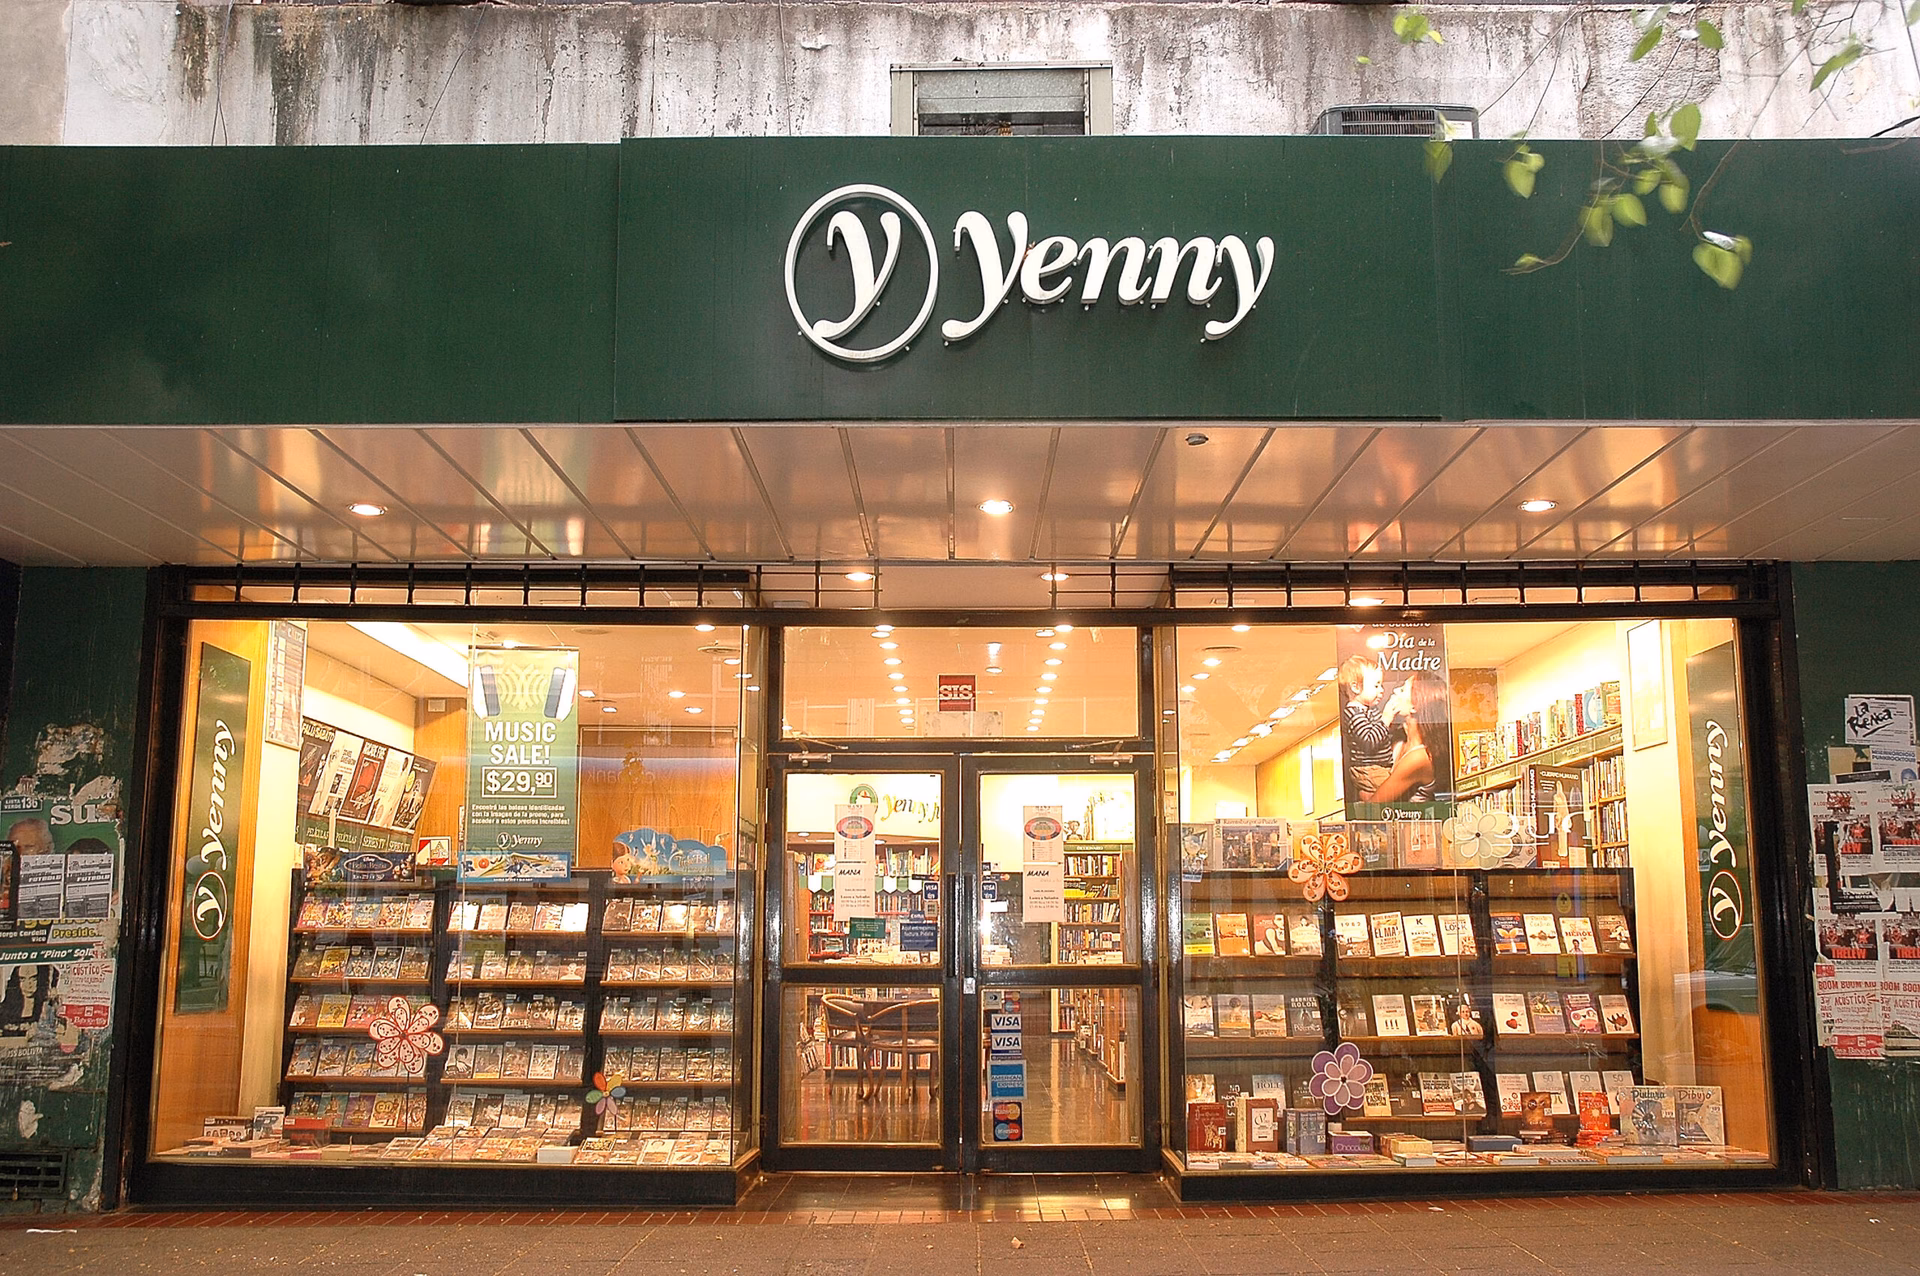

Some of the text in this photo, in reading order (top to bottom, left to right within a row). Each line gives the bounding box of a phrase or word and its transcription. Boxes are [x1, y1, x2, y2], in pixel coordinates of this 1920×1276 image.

[941, 210, 1276, 341] Yenny
[1378, 651, 1441, 671] Madre
[939, 684, 973, 700] SIS
[484, 721, 557, 743] MUSIC
[490, 744, 550, 765] SALE!
[486, 769, 553, 797] $29,90
[201, 718, 236, 871] Yenny
[1706, 718, 1737, 869] Yenny
[21, 797, 38, 809] 136
[1394, 808, 1422, 820] Yenny
[511, 833, 543, 848] Yenny
[0, 951, 29, 961] Junto
[1818, 981, 1838, 990] BOOM
[994, 1016, 1020, 1026] VISA
[994, 1037, 1020, 1047] VISA
[1678, 1089, 1712, 1101] Dibujo
